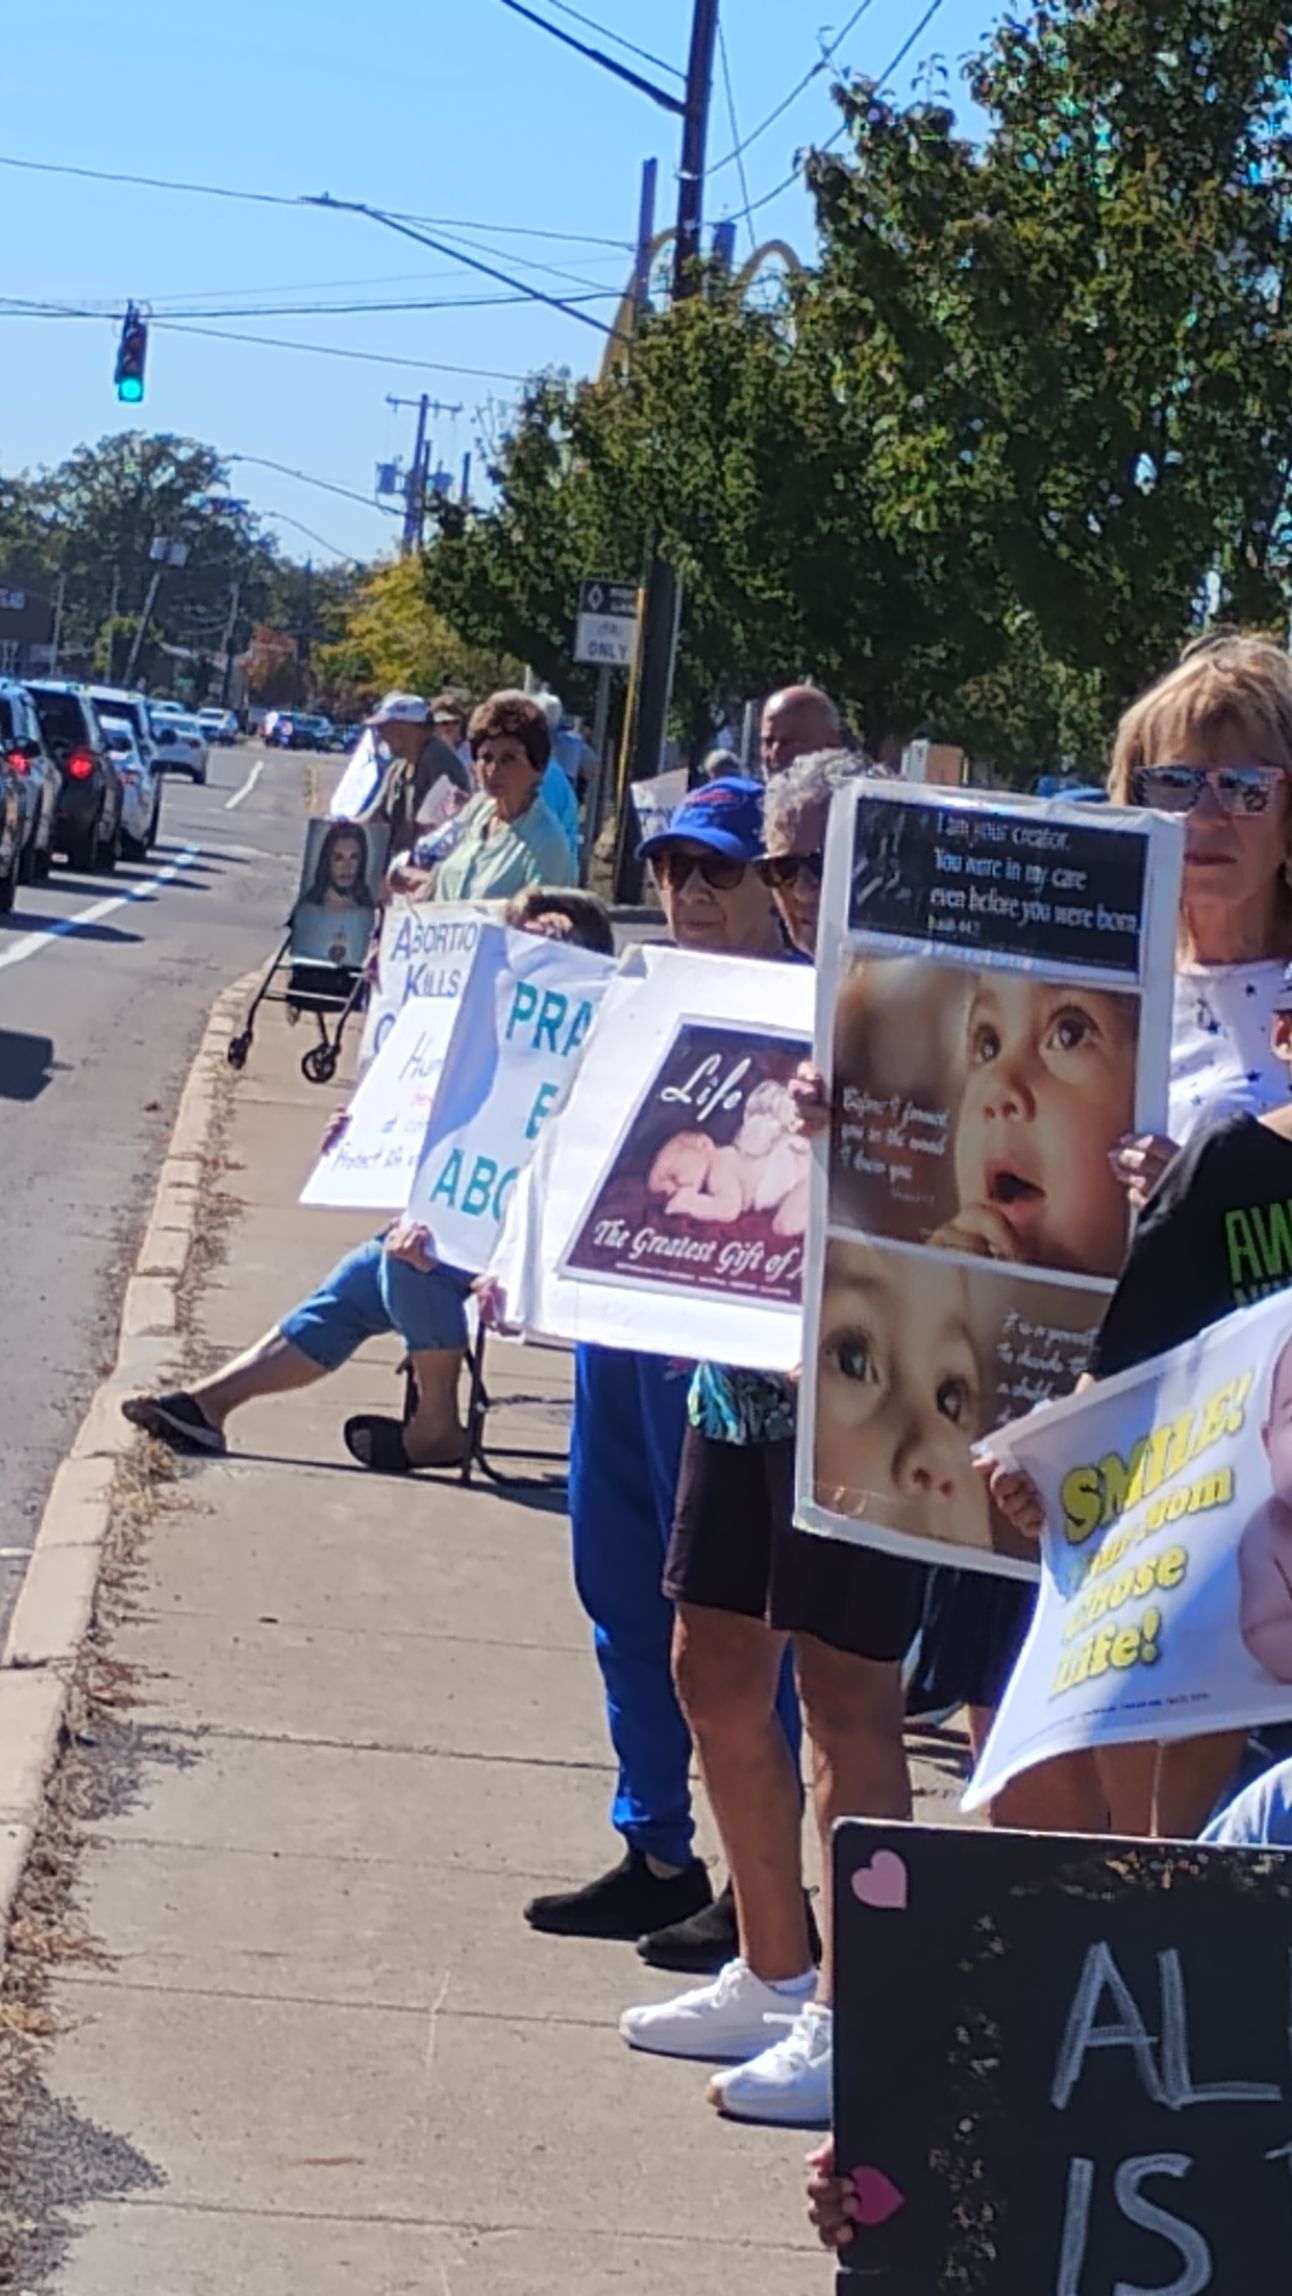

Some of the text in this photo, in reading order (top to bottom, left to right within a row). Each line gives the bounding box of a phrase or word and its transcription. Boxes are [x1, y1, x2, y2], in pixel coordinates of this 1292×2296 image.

[587, 640, 628, 660] ONLY
[934, 846, 962, 871] You
[965, 855, 1002, 877] were
[1005, 857, 1020, 880] in
[1051, 868, 1087, 890] care
[930, 886, 965, 909] even
[969, 884, 1020, 918] before
[1018, 901, 1050, 927] you
[1054, 904, 1093, 928] were
[661, 1053, 751, 1121] Life
[594, 1219, 630, 1248] The
[628, 1227, 717, 1260] Greatest
[714, 1241, 764, 1277] Gift
[764, 1247, 800, 1282] of
[1060, 1369, 1254, 1545] SMILE!
[1057, 2152, 1212, 2296] IS
